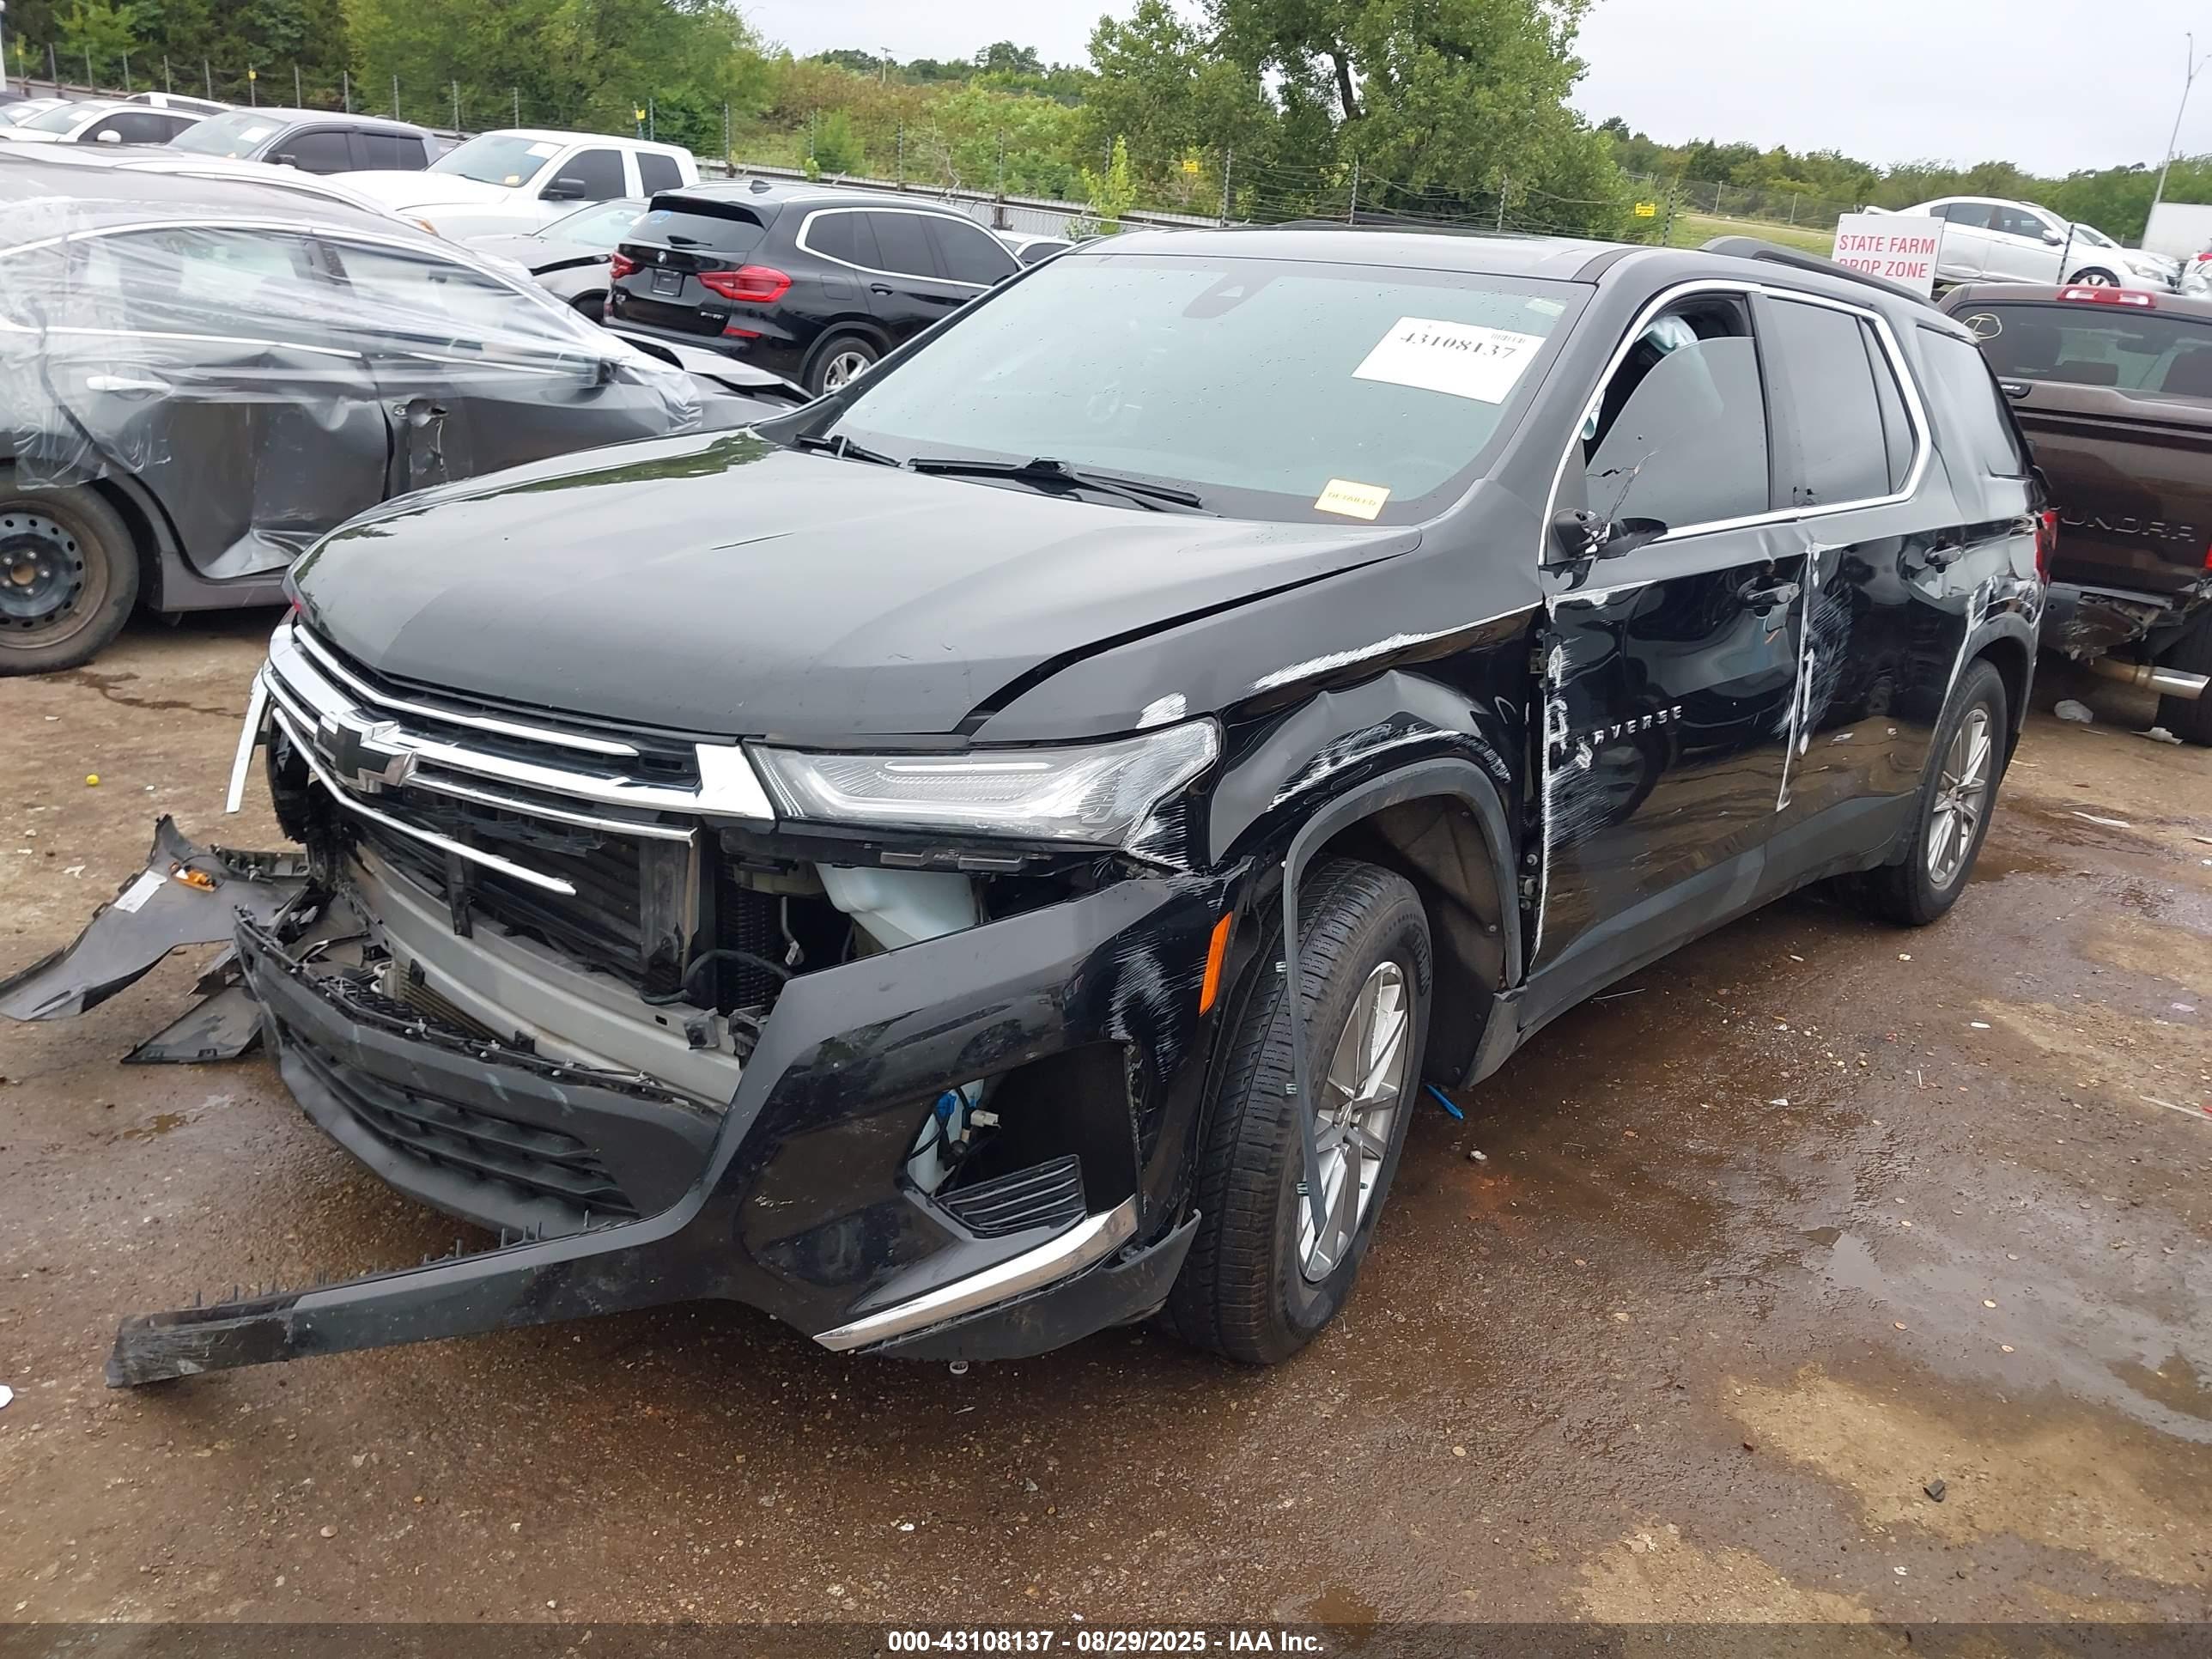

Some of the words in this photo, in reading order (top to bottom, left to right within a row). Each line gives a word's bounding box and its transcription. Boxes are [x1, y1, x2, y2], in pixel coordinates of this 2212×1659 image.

[1838, 234, 1886, 252] STATE
[1889, 237, 1936, 255] FARM
[1884, 261, 1929, 278] ZONE
[1400, 332, 1517, 359] 43108137
[2050, 505, 2197, 543] UNDRA
